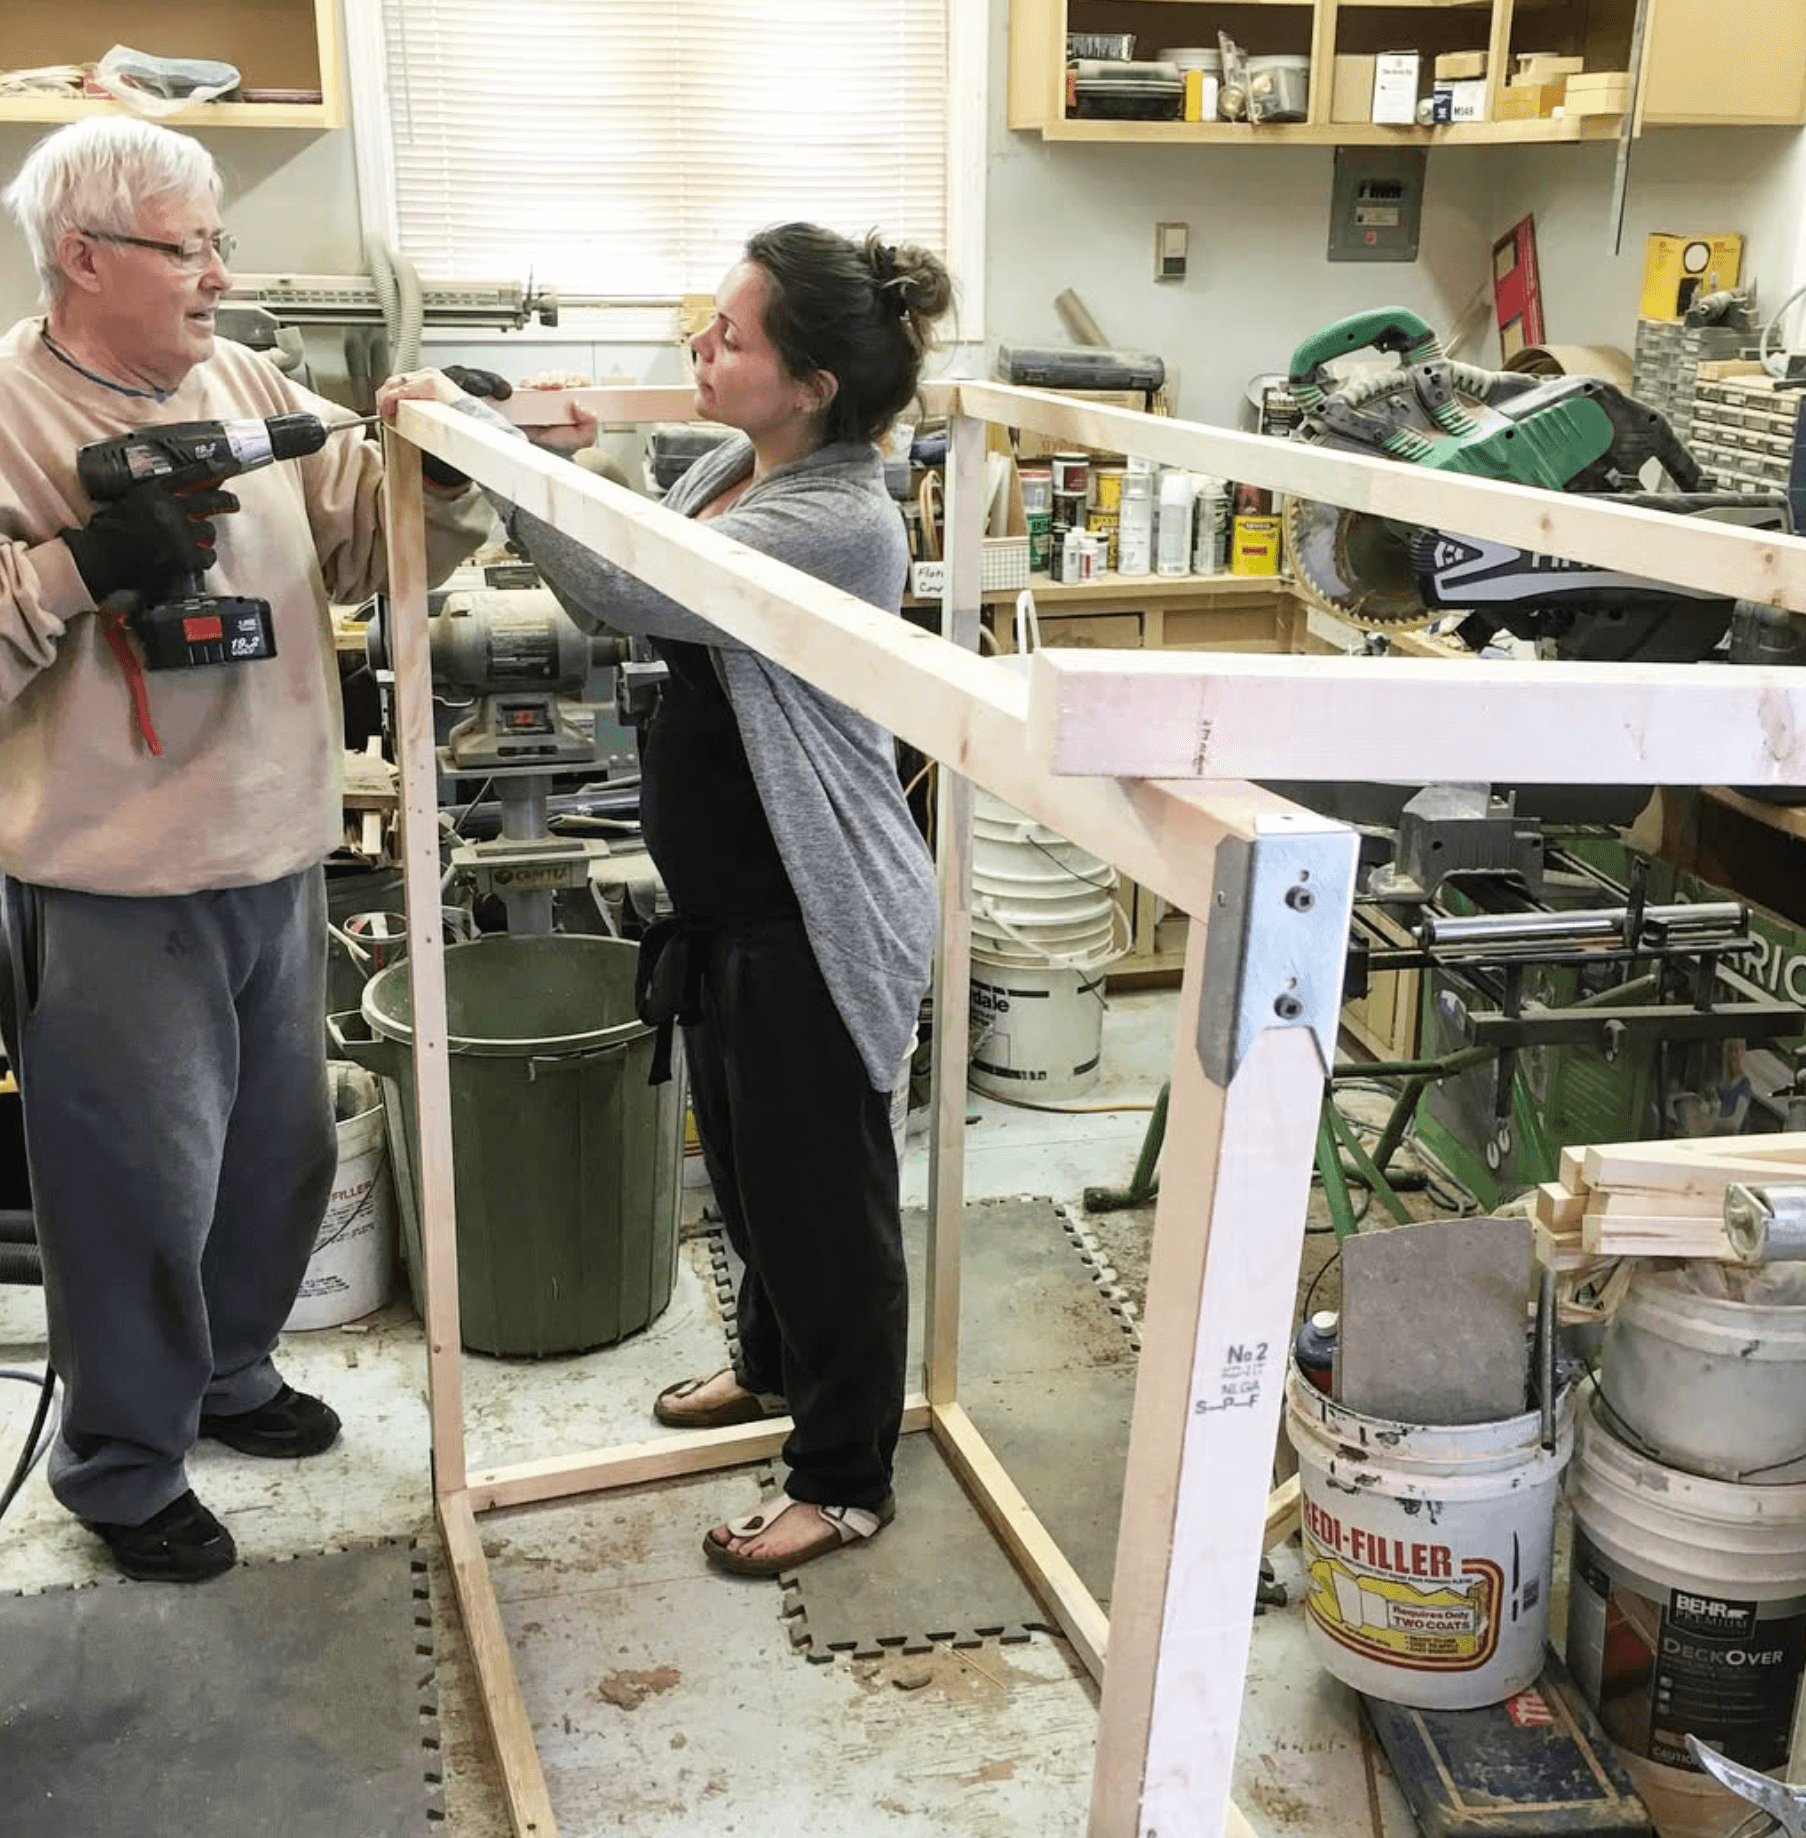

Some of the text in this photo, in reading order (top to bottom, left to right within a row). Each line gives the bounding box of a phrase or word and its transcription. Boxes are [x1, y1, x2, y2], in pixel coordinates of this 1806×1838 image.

[1676, 1593, 1728, 1618] BEHR
[1393, 1616, 1471, 1631] TWO COATS
